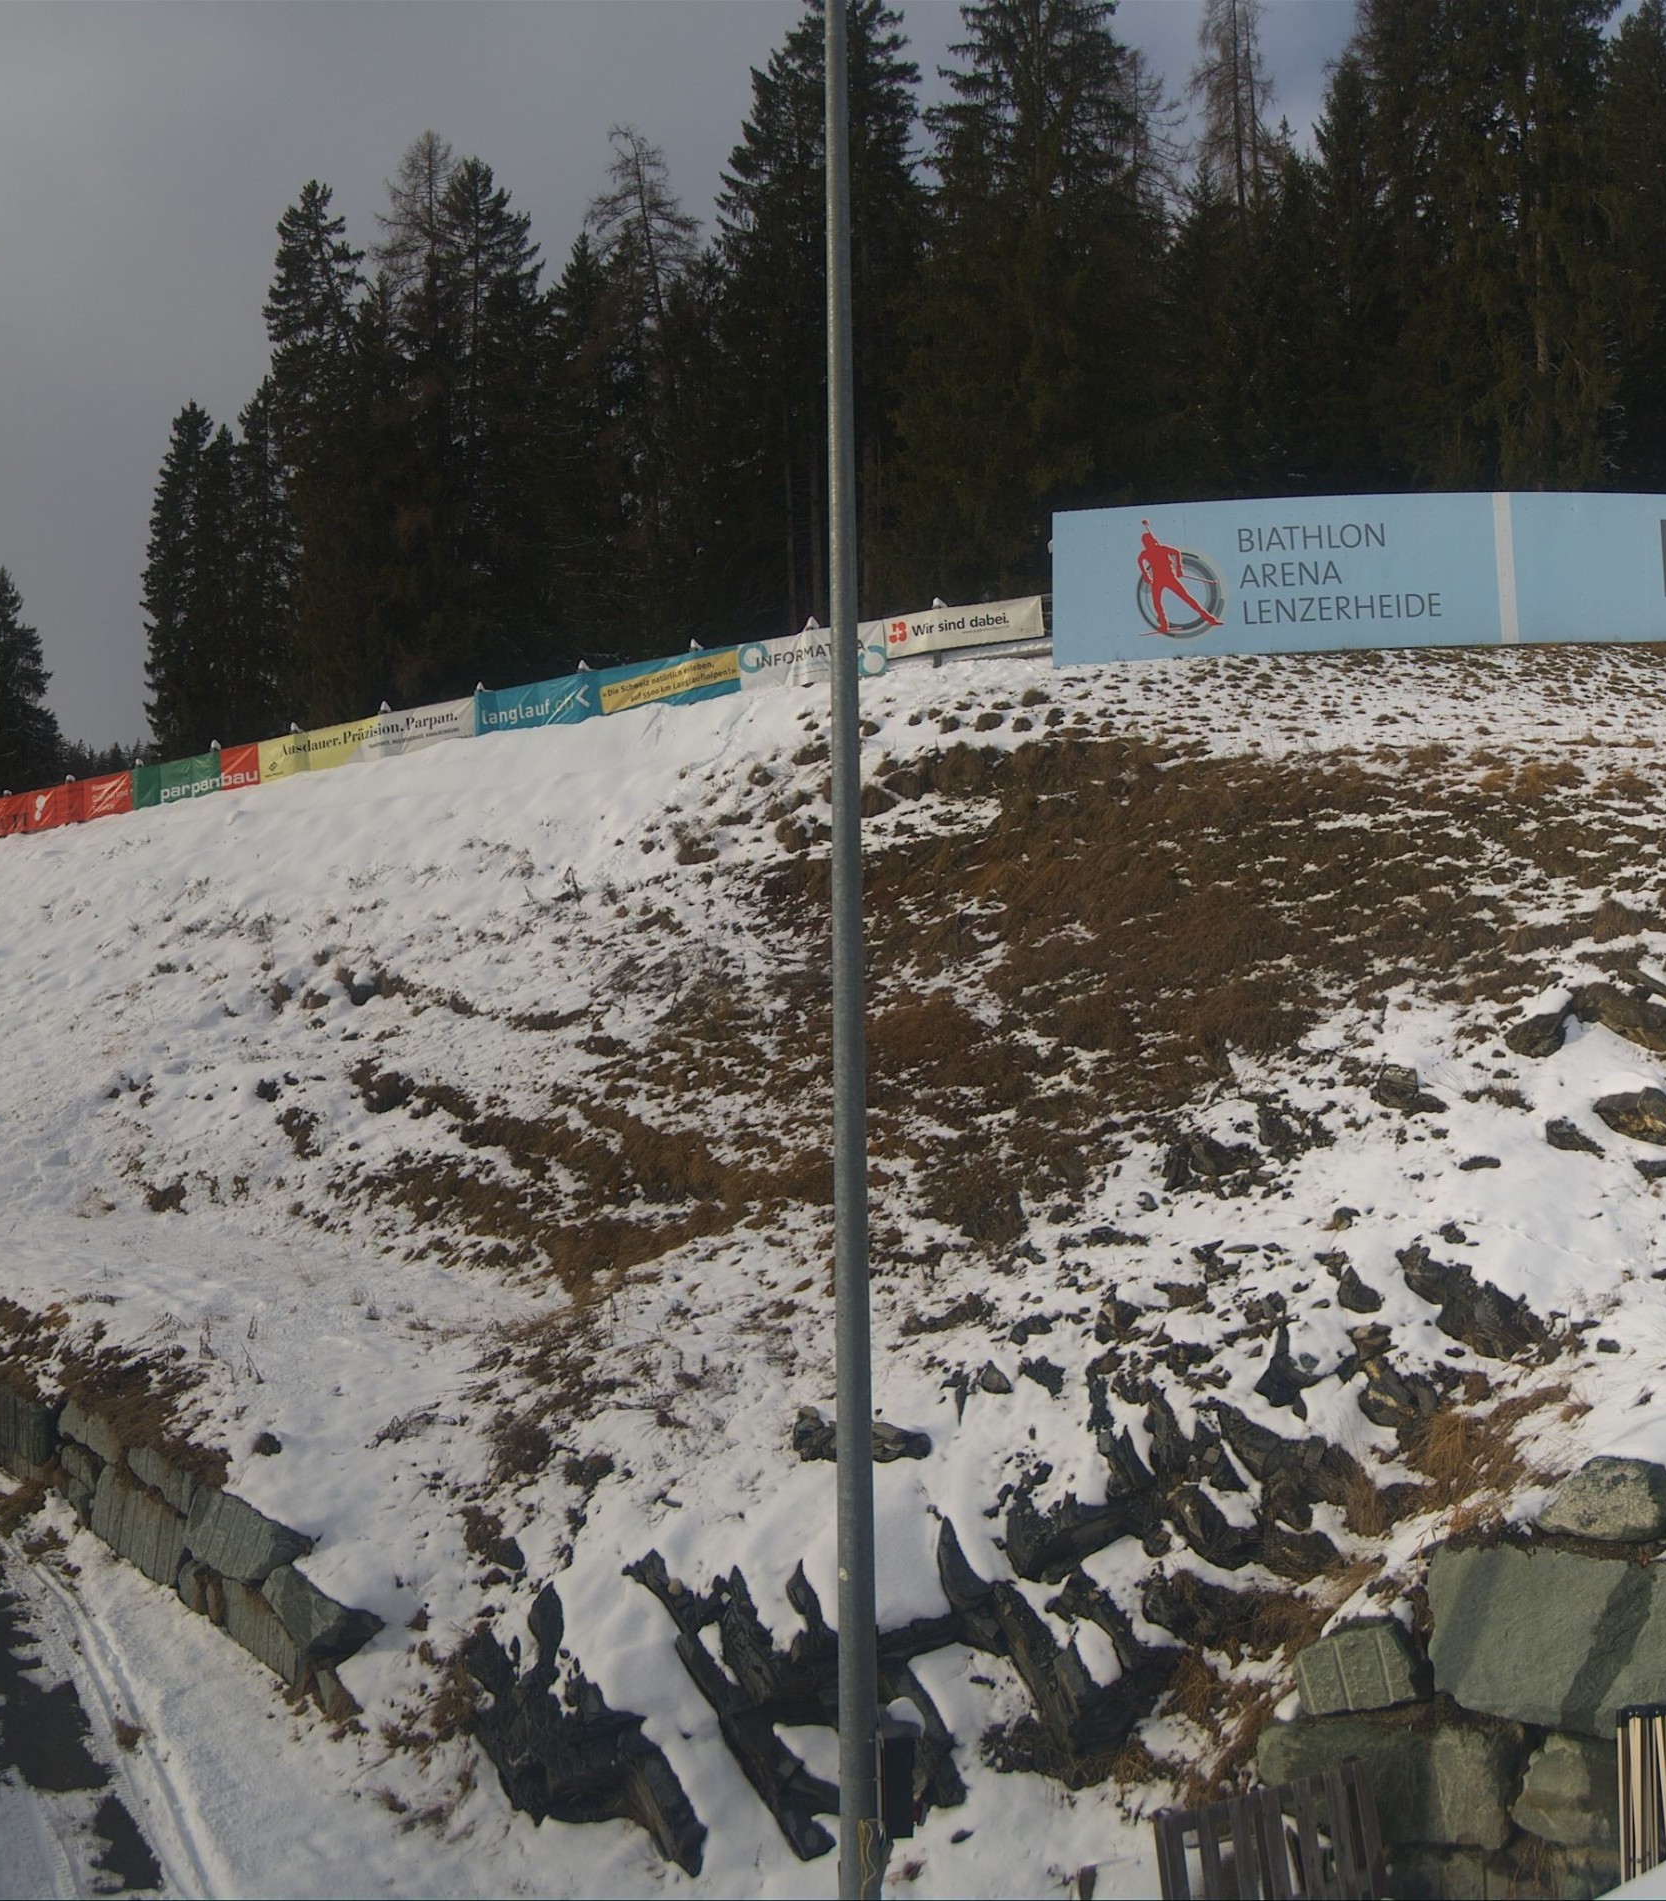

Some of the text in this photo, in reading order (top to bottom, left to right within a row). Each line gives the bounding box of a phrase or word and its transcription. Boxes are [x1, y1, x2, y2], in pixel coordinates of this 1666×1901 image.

[1237, 522, 1387, 553] BIATHLON
[1239, 560, 1344, 589] ARENA
[1242, 592, 1443, 626] LENZERHEIDE
[911, 624, 934, 637] Wir
[938, 617, 965, 633] sind
[969, 612, 1010, 628] dabei.
[620, 678, 650, 694] Schweiz
[660, 683, 672, 694] km
[342, 722, 404, 745] Präzision.
[405, 711, 458, 731] Parpan.
[160, 769, 259, 803] parpanbau
